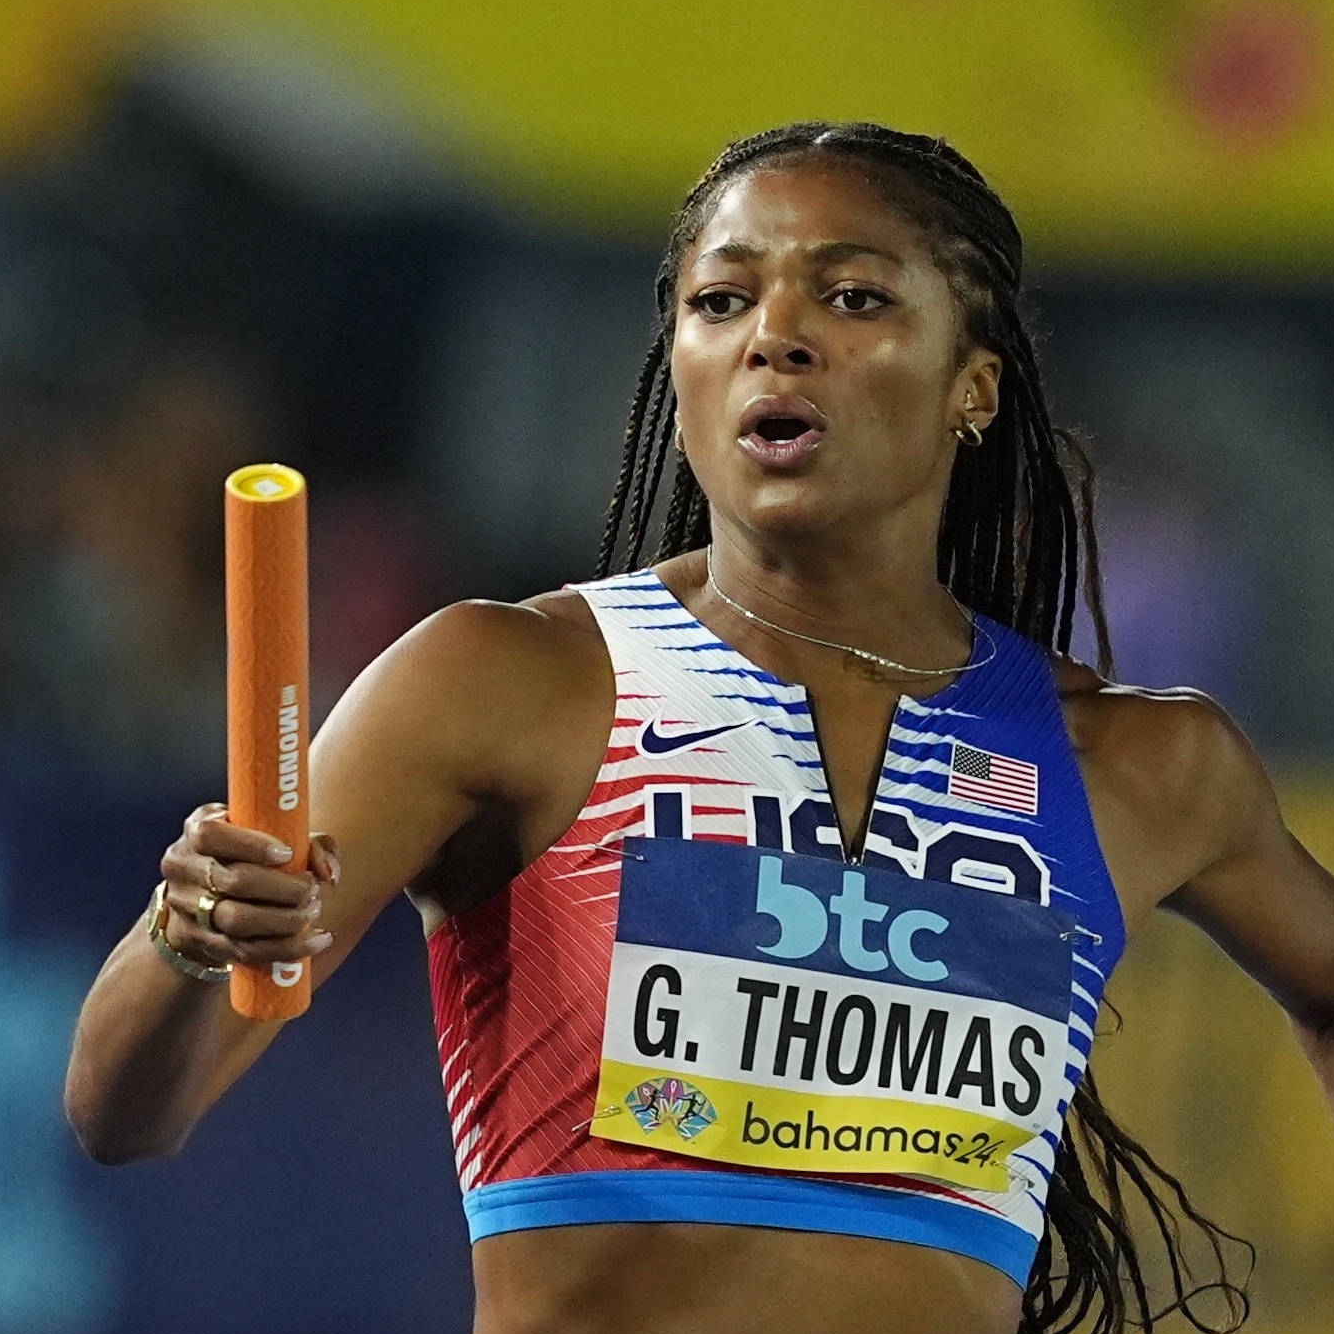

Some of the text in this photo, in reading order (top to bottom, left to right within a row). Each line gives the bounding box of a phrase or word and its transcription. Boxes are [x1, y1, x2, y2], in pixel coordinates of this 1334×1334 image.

[278, 703, 300, 811] MONDO
[755, 855, 950, 982] btc
[633, 964, 1046, 1117] G. THOMAS
[742, 1100, 1005, 1167] bahamas24
